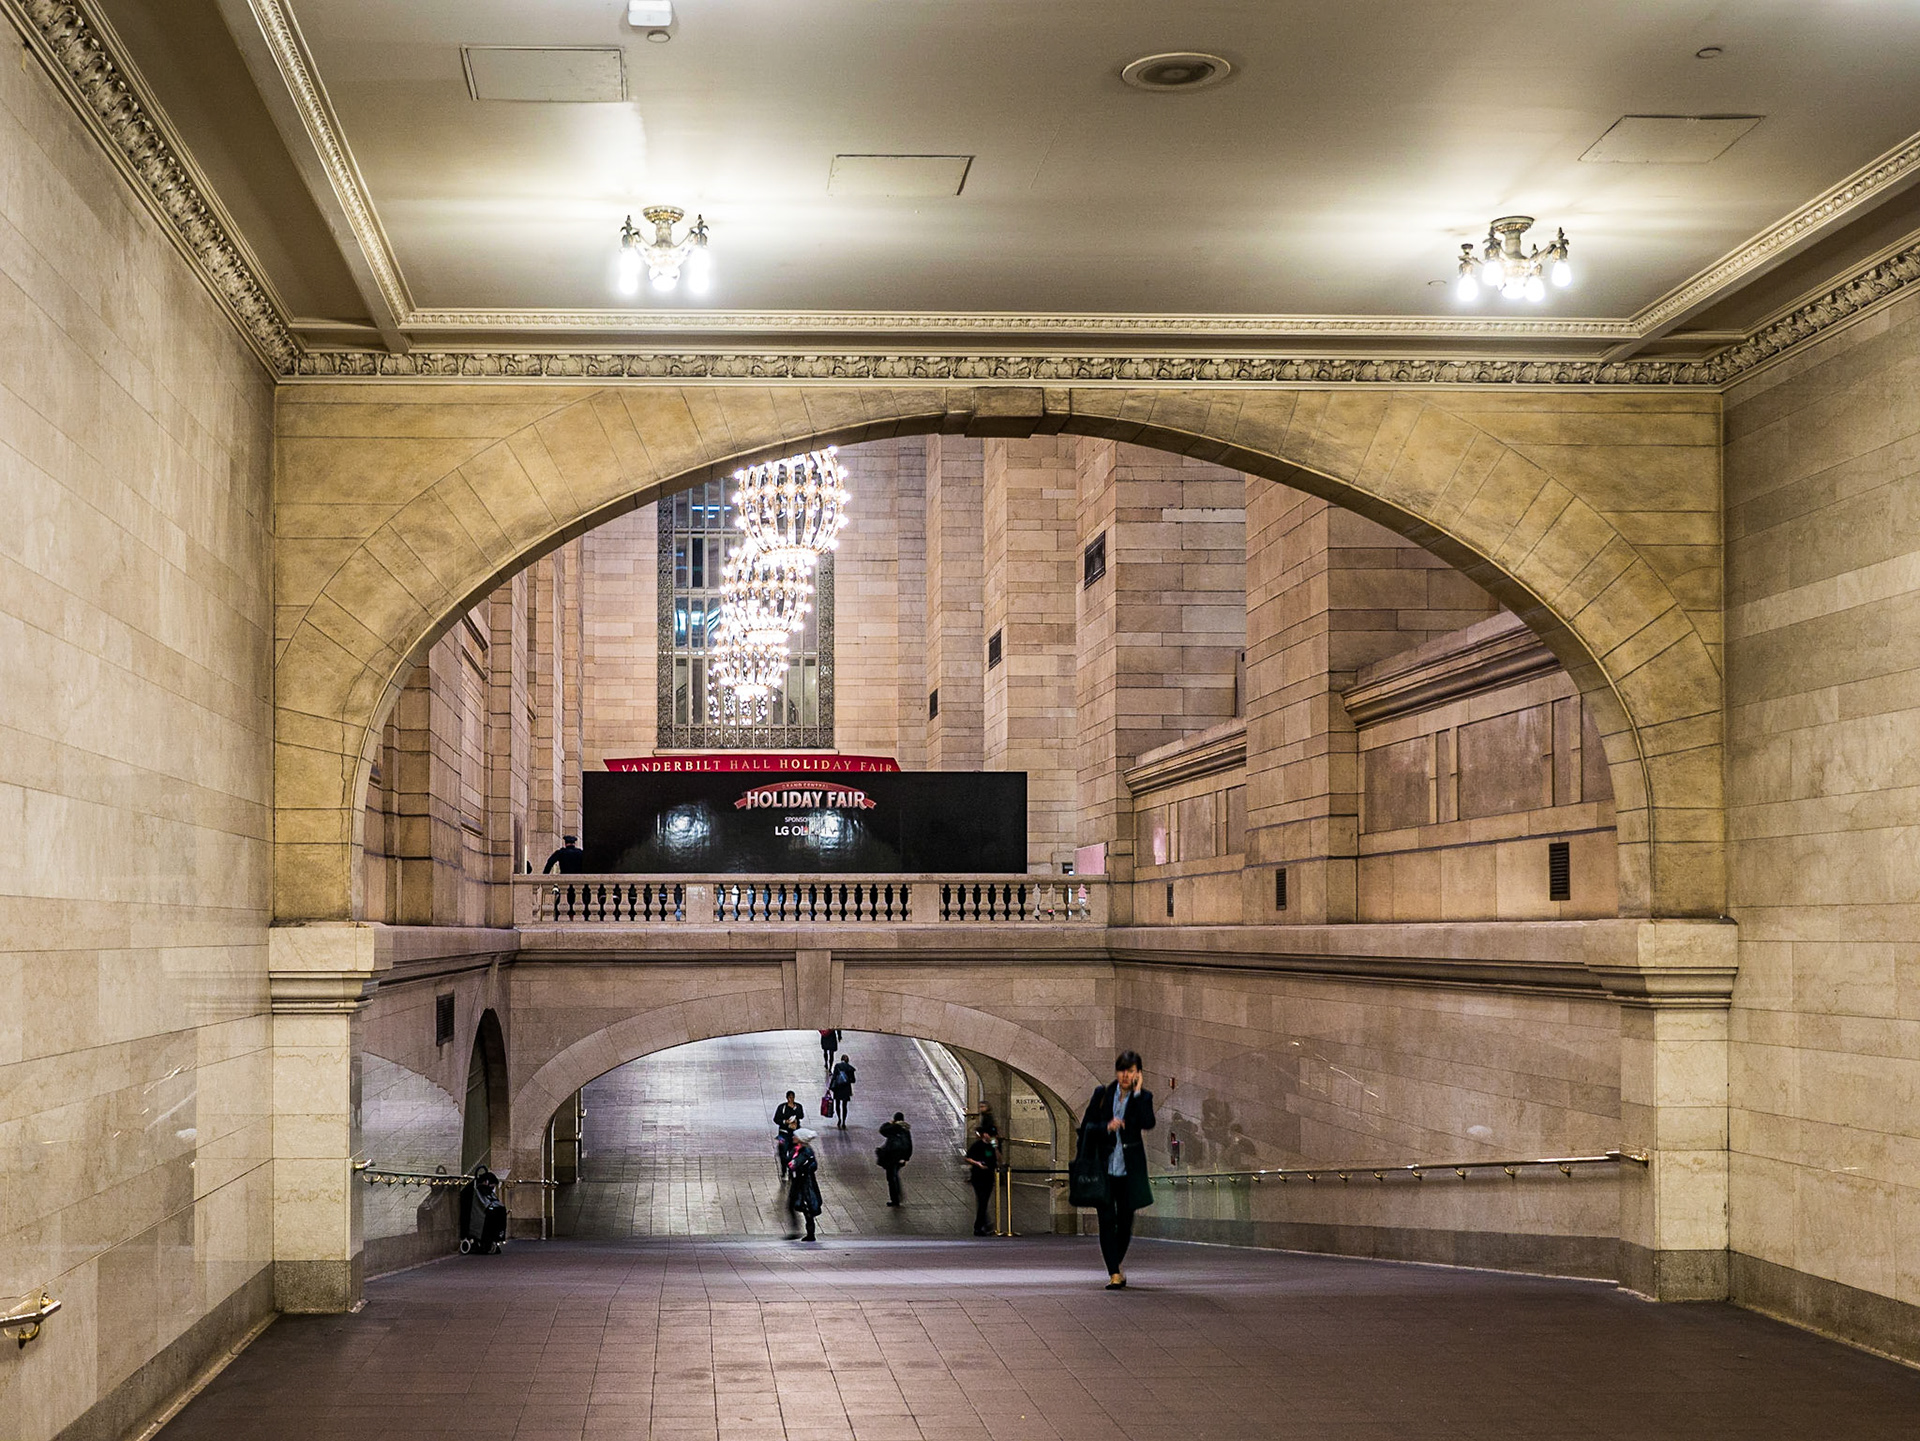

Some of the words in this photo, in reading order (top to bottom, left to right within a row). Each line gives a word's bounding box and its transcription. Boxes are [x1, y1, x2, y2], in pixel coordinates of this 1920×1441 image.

[621, 760, 721, 772] VANDERBILT
[730, 759, 771, 770] HALL
[780, 759, 852, 770] HOLIDAY
[860, 761, 892, 772] FAIR
[746, 791, 823, 810] HOLIDAY
[826, 791, 868, 810] FAIR
[775, 826, 790, 836] LG
